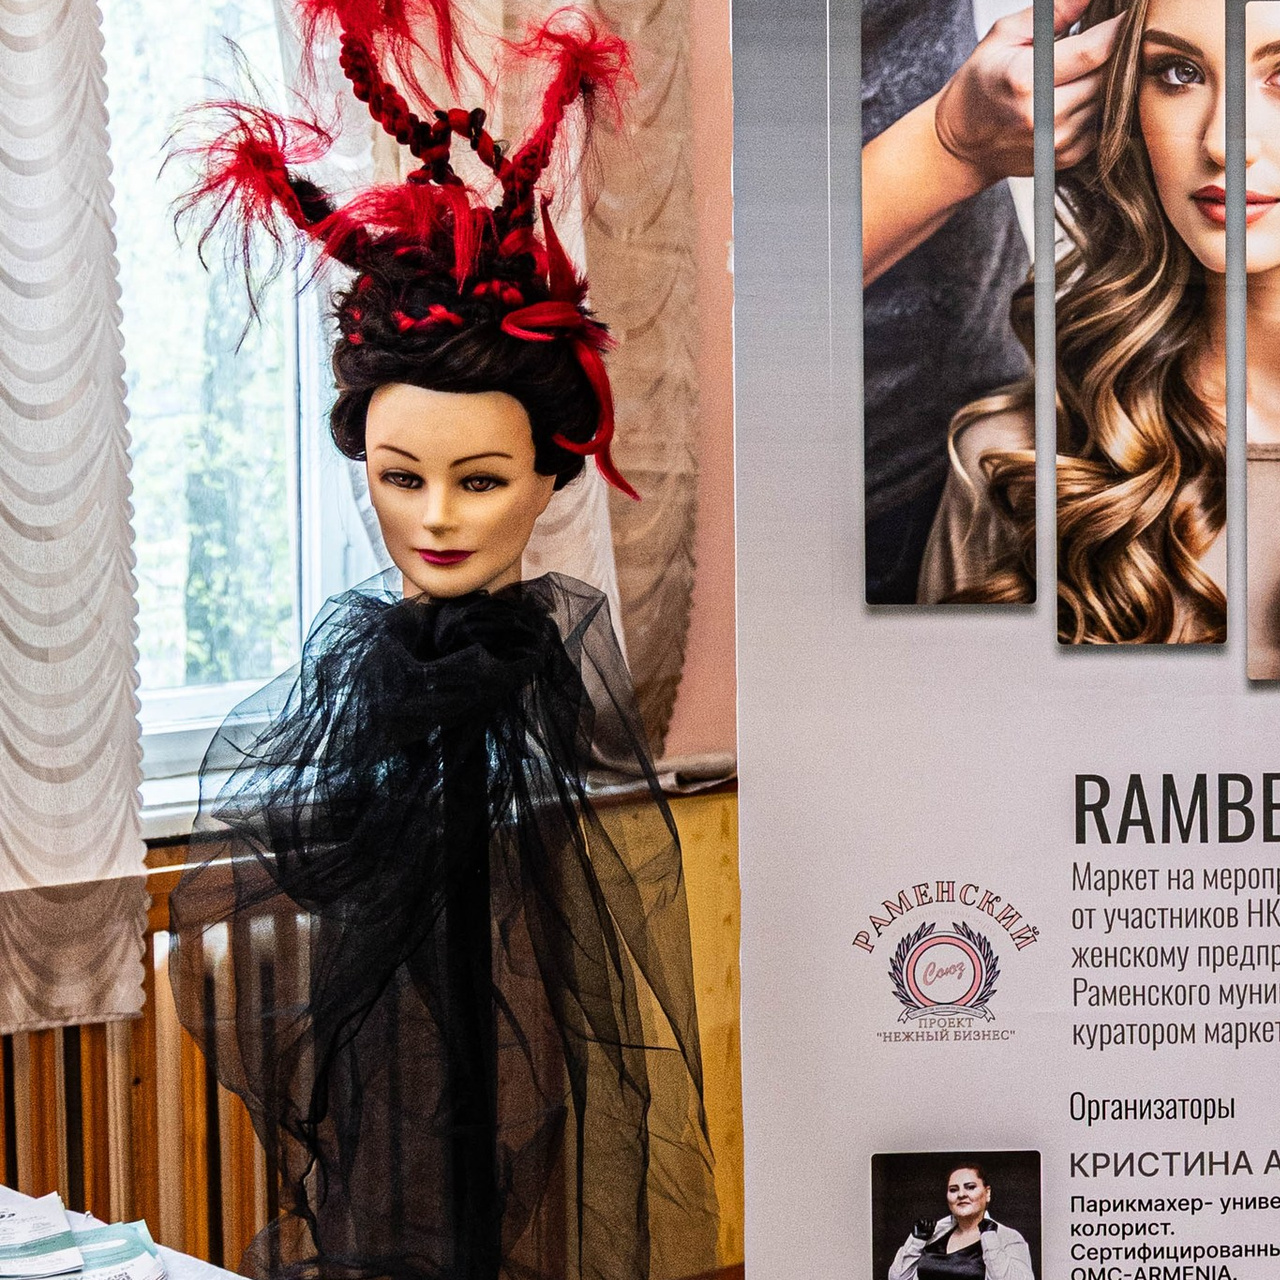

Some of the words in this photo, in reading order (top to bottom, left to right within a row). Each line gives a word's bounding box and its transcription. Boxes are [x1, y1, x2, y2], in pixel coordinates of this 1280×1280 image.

[1072, 861, 1160, 898] Маркет
[1167, 868, 1194, 891] на
[852, 880, 1040, 954] РАМЕНСКИЙ
[1071, 907, 1097, 930] от
[1103, 906, 1239, 935] участников
[1071, 945, 1190, 973] женскому
[922, 961, 966, 986] Союз
[1073, 977, 1211, 1007] Раменского
[876, 1029, 950, 1043] "НЕЖНЫЙ
[953, 1029, 1016, 1042] БИЗНЕС"
[918, 1017, 975, 1029] ПРОЕКТ
[1072, 1022, 1196, 1052] куратором
[1069, 1091, 1235, 1128] Организаторы
[1070, 1150, 1254, 1178] КРИСТИНА
[1070, 1195, 1213, 1217] Парикмахер-
[1070, 1222, 1175, 1241] колорист.
